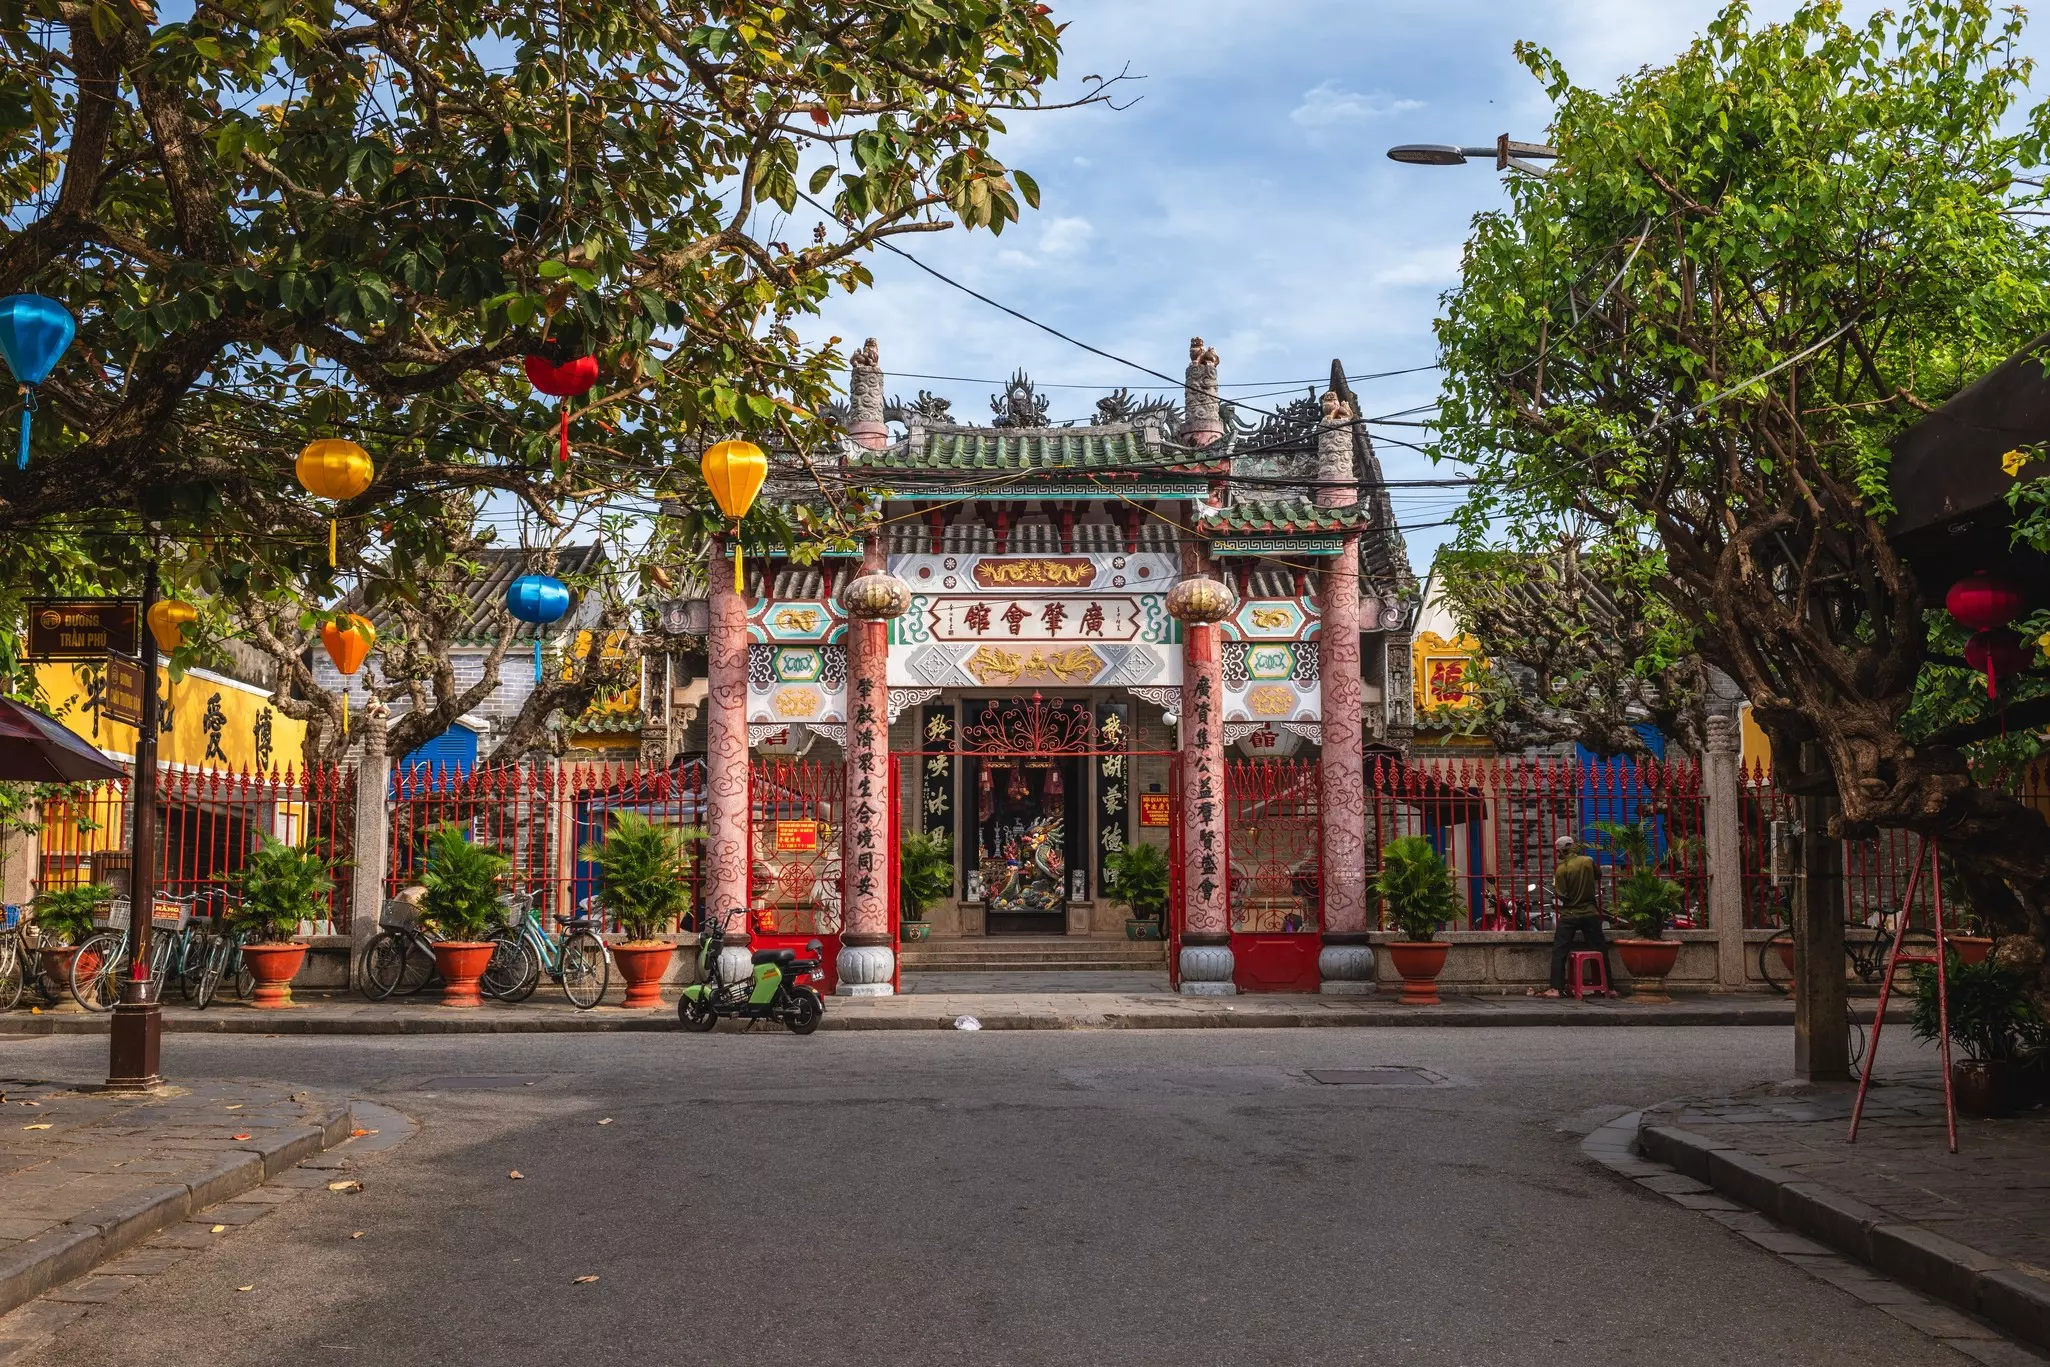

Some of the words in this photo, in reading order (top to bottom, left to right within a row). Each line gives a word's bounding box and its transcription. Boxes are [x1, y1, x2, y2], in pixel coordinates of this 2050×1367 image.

[60, 628, 85, 647] TRẦN
[87, 631, 107, 647] PHÚ
[963, 601, 1105, 638] 廣肇會館
[1430, 660, 1465, 702] 福
